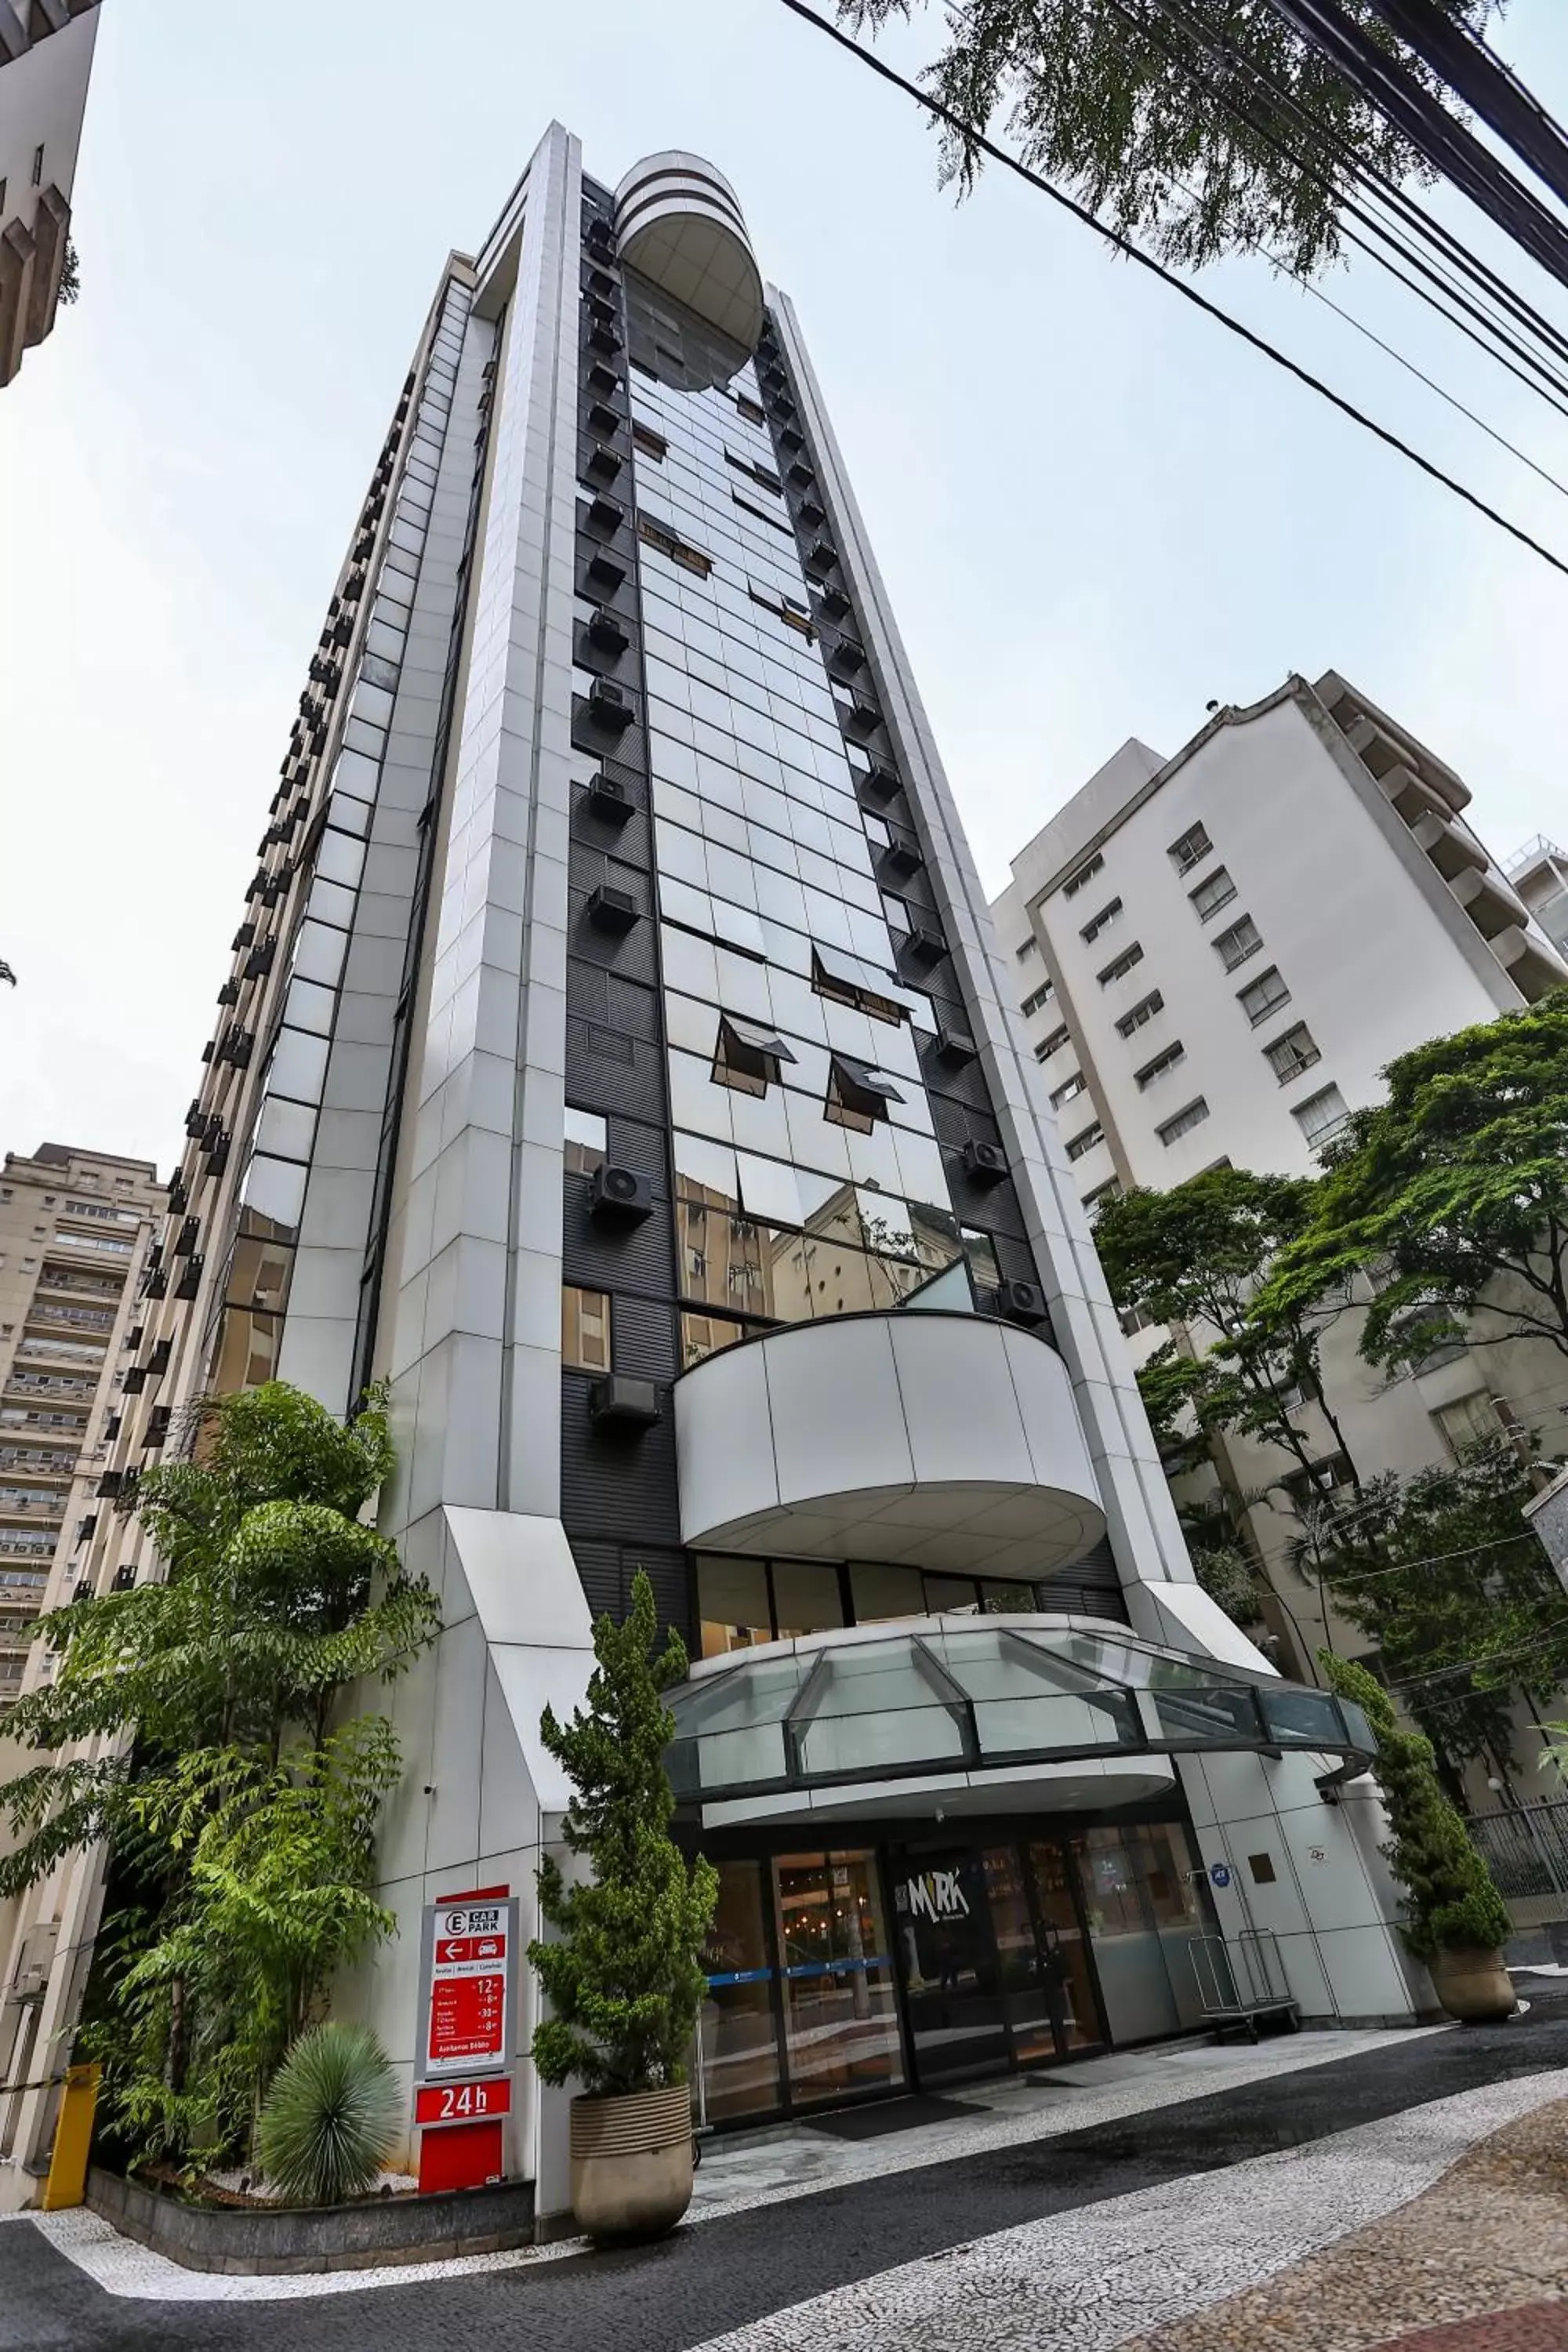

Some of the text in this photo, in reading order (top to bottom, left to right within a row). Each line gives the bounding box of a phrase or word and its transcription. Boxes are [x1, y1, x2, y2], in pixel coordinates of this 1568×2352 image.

[473, 1911, 497, 1922] CAR
[452, 1916, 462, 1931] E
[468, 1922, 499, 1933] PARK
[440, 2085, 487, 2118] 24h
